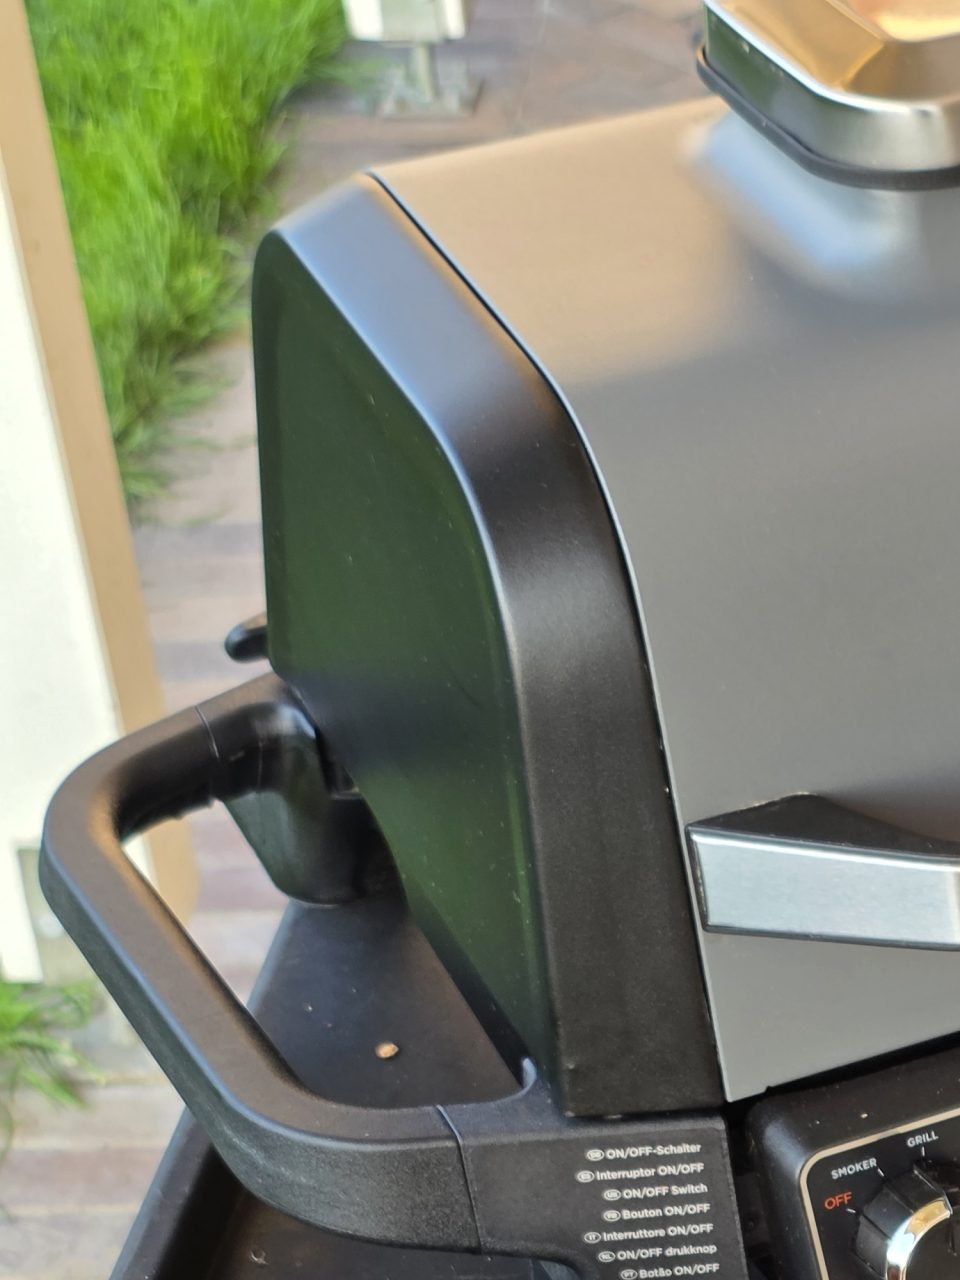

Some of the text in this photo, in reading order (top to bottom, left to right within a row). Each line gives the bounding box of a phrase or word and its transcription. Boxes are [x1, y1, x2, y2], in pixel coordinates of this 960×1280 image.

[906, 1130, 939, 1148] GRILL
[606, 1143, 701, 1160] ON/OFF-Schalter
[596, 1166, 656, 1181] Interruptor
[658, 1162, 704, 1177] ON/OFF
[831, 1157, 877, 1180] SMOKER
[623, 1186, 669, 1199] ON/OFF
[671, 1183, 708, 1195] Switch
[824, 1191, 852, 1209] OFF
[622, 1208, 663, 1220] Bouton
[664, 1203, 711, 1217] ON/OFF
[603, 1227, 665, 1242] Interruttore
[667, 1223, 714, 1237] ON/OFF
[617, 1248, 662, 1261] ON/OFF
[664, 1244, 717, 1256] drukknop
[674, 1263, 720, 1276] ON/OFF
